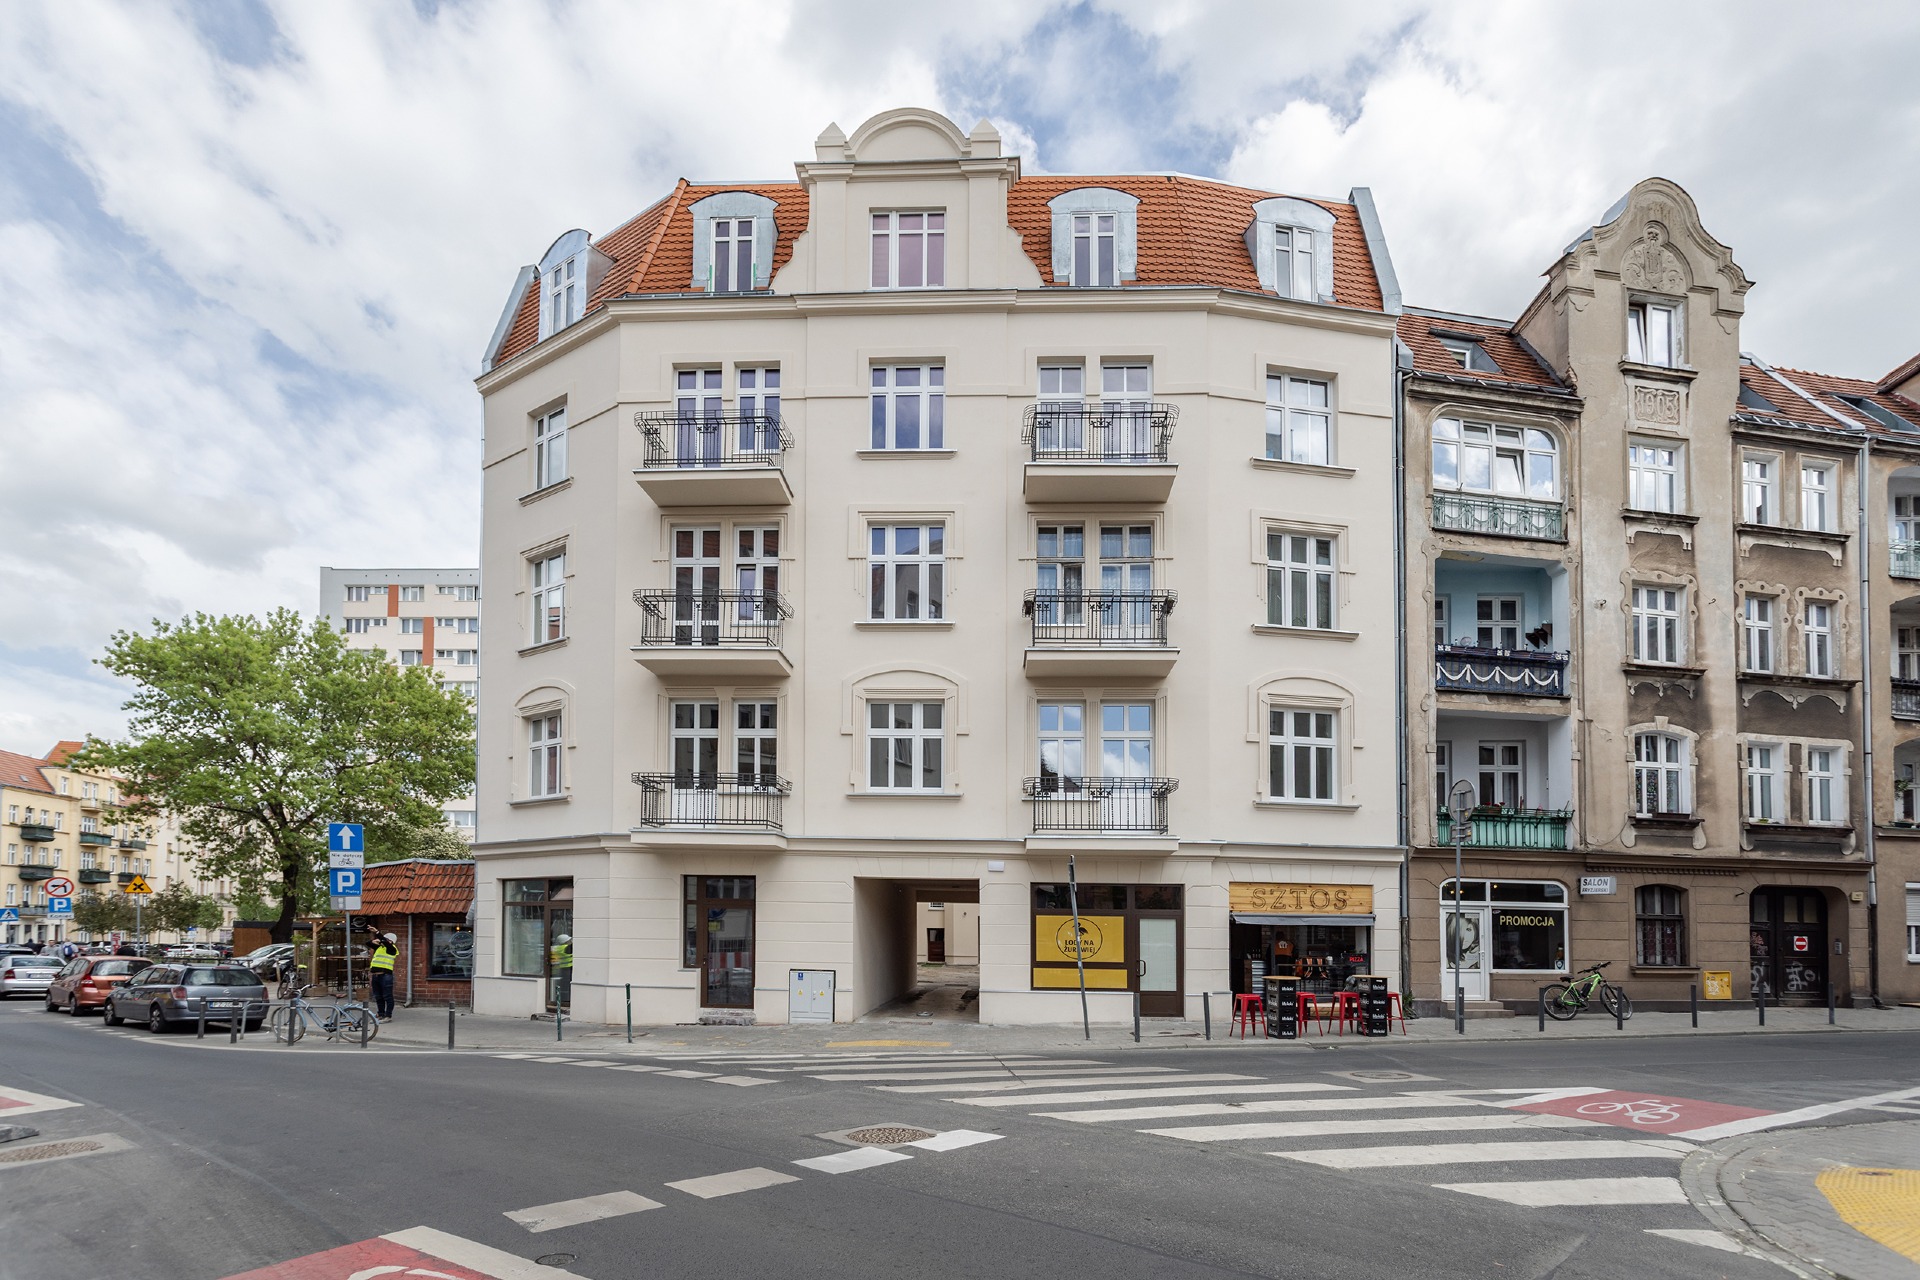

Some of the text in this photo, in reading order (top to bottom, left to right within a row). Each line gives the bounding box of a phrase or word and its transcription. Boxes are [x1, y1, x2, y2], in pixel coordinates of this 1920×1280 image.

[1640, 393, 1674, 417] 1905
[337, 872, 355, 892] P
[1582, 878, 1609, 886] SALON
[53, 899, 67, 911] P
[1252, 888, 1348, 910] SZTOS
[1499, 915, 1555, 927] PROMOCJA
[1064, 946, 1096, 954] ŻURWIEJ
